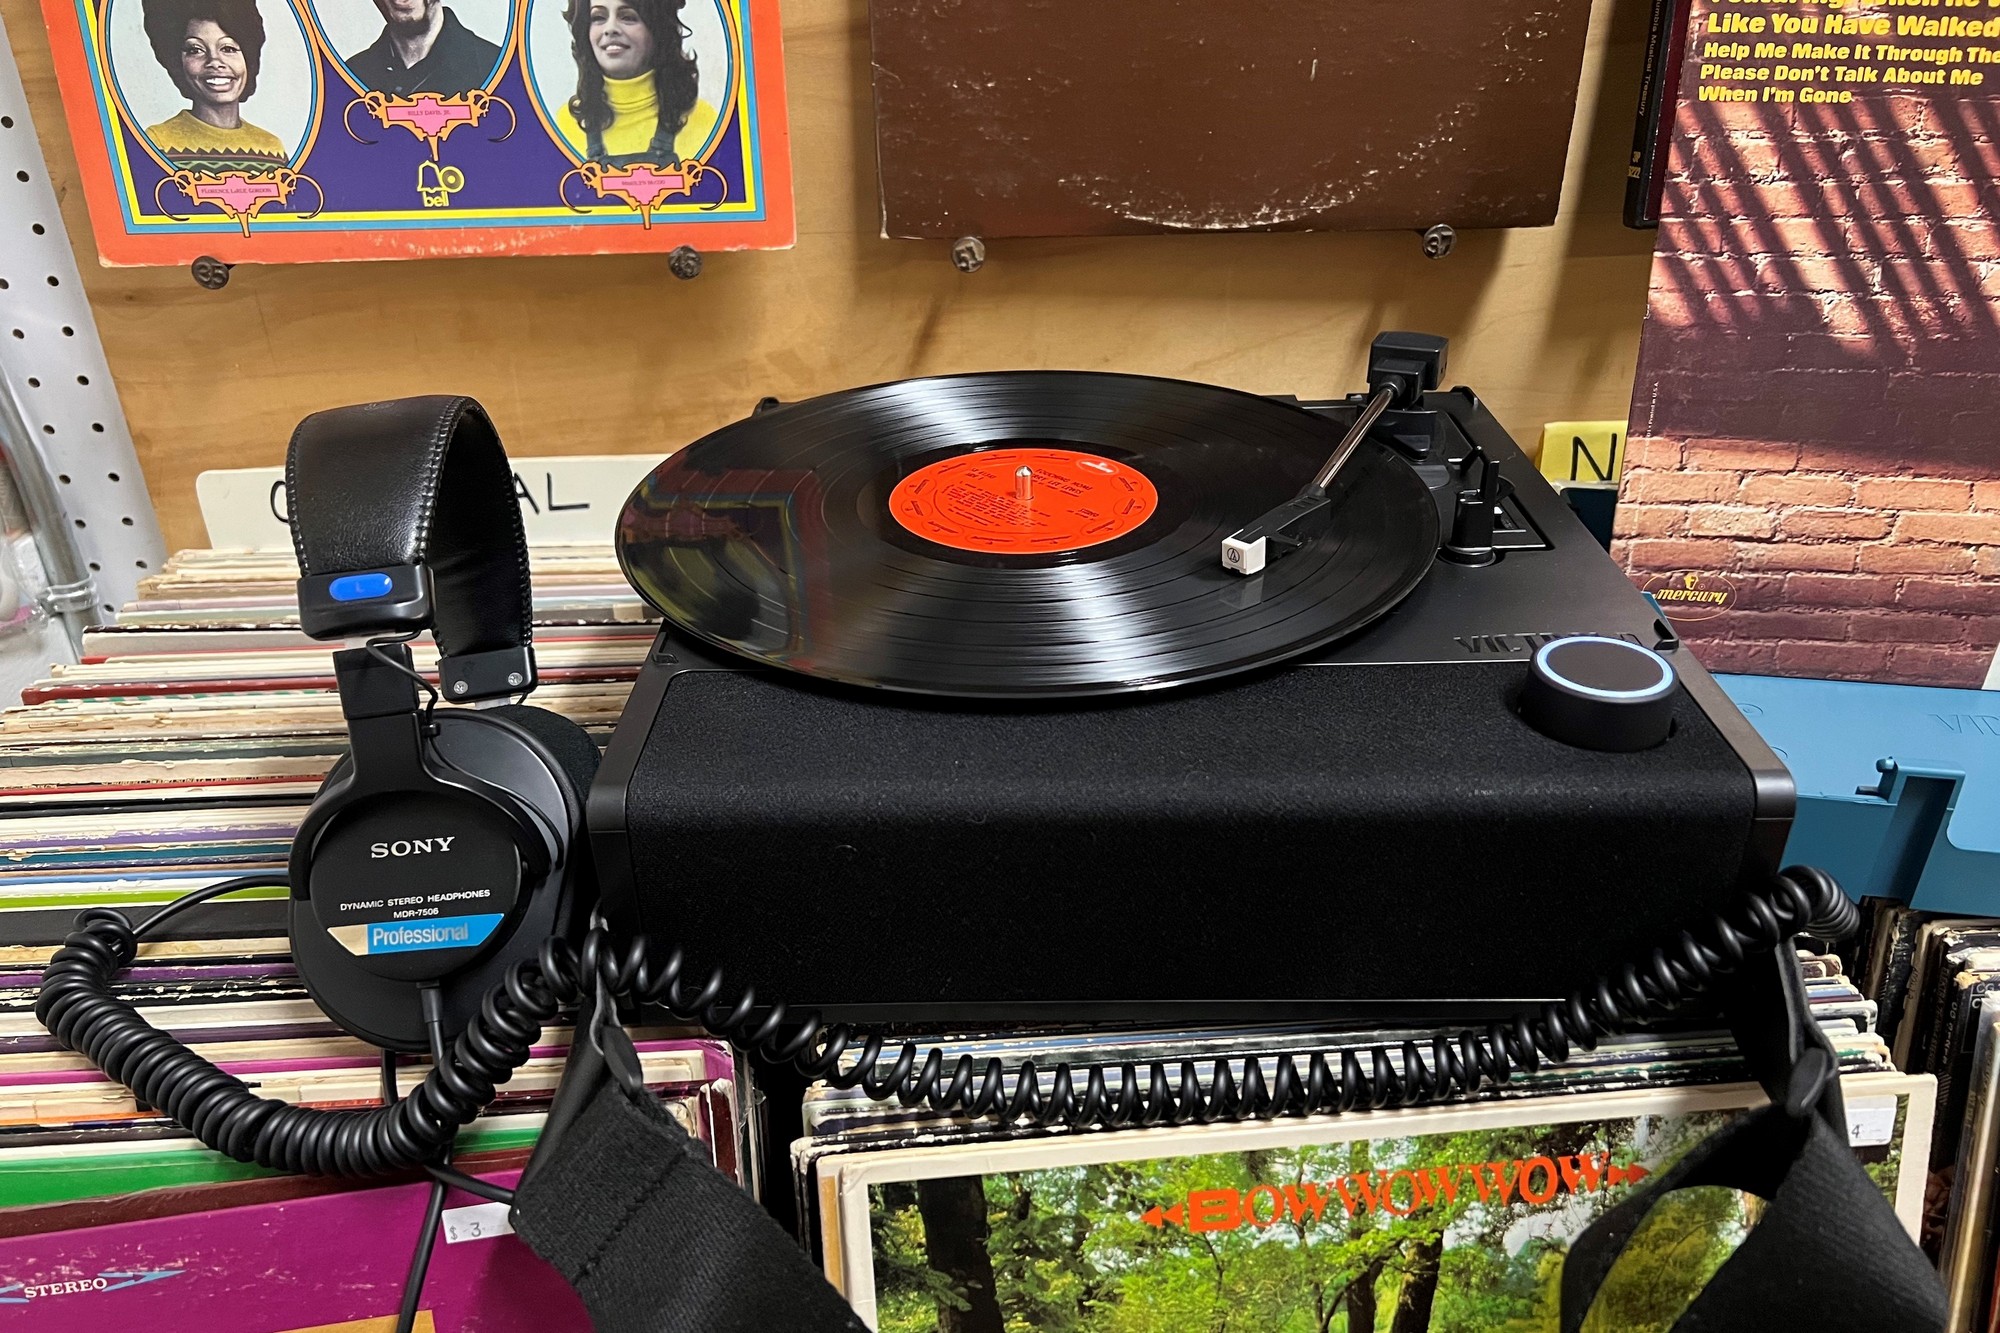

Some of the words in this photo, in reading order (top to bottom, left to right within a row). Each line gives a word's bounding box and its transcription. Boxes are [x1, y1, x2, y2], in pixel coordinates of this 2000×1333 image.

[1707, 13, 1766, 34] Like
[1771, 13, 1819, 35] You
[1824, 14, 1891, 35] Have
[1897, 15, 2000, 37] Walked
[1644, 35, 1657, 73] Musical
[1704, 42, 1749, 62] Help
[1755, 43, 1788, 60] Me
[1791, 43, 1850, 60] Make
[1854, 44, 1871, 61] It
[1875, 45, 1962, 66] Through
[1967, 46, 2000, 64] The
[1700, 64, 1769, 81] Please
[1774, 65, 1829, 82] Don't
[1834, 66, 1878, 83] Talk
[1882, 67, 1946, 84] About
[1949, 69, 1984, 86] Me
[1638, 75, 1652, 117] Treasury
[1698, 86, 1757, 102] When
[1762, 87, 1795, 103] I'm
[1799, 87, 1852, 104] Gone
[422, 191, 450, 207] bell
[1571, 433, 1617, 481] N
[1653, 589, 1728, 606] mercury
[370, 836, 455, 859] SONY
[340, 899, 384, 911] DYNAMIC
[387, 896, 424, 907] STEREO
[427, 889, 491, 903] HEADPHONES
[393, 907, 439, 919] MDR-7506
[373, 923, 469, 947] Professional
[24, 1276, 108, 1299] STEREO
